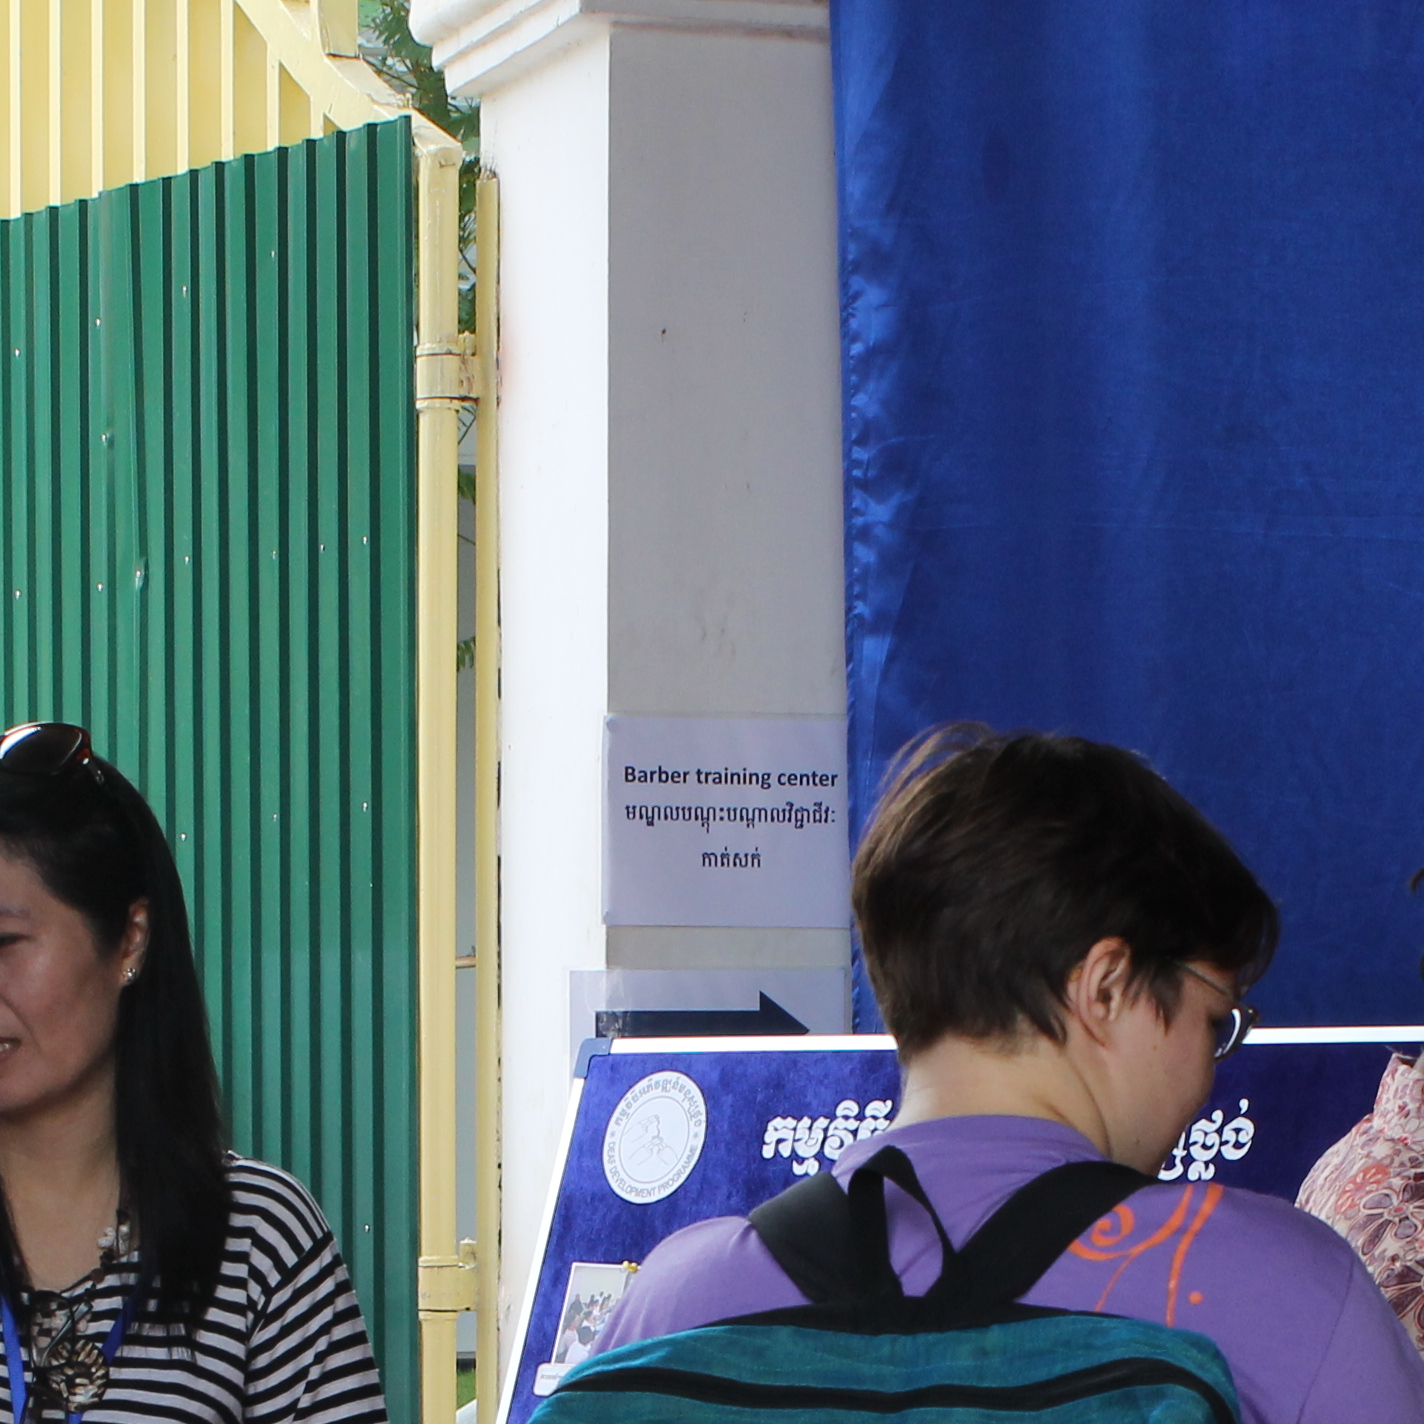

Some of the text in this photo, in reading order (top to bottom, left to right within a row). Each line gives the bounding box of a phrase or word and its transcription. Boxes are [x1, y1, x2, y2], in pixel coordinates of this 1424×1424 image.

[624, 765, 838, 789] Barber training center
[701, 847, 761, 868] កាត់សក់
[607, 1141, 698, 1198] DEAF DEVELOPMENT PROGRAMME
